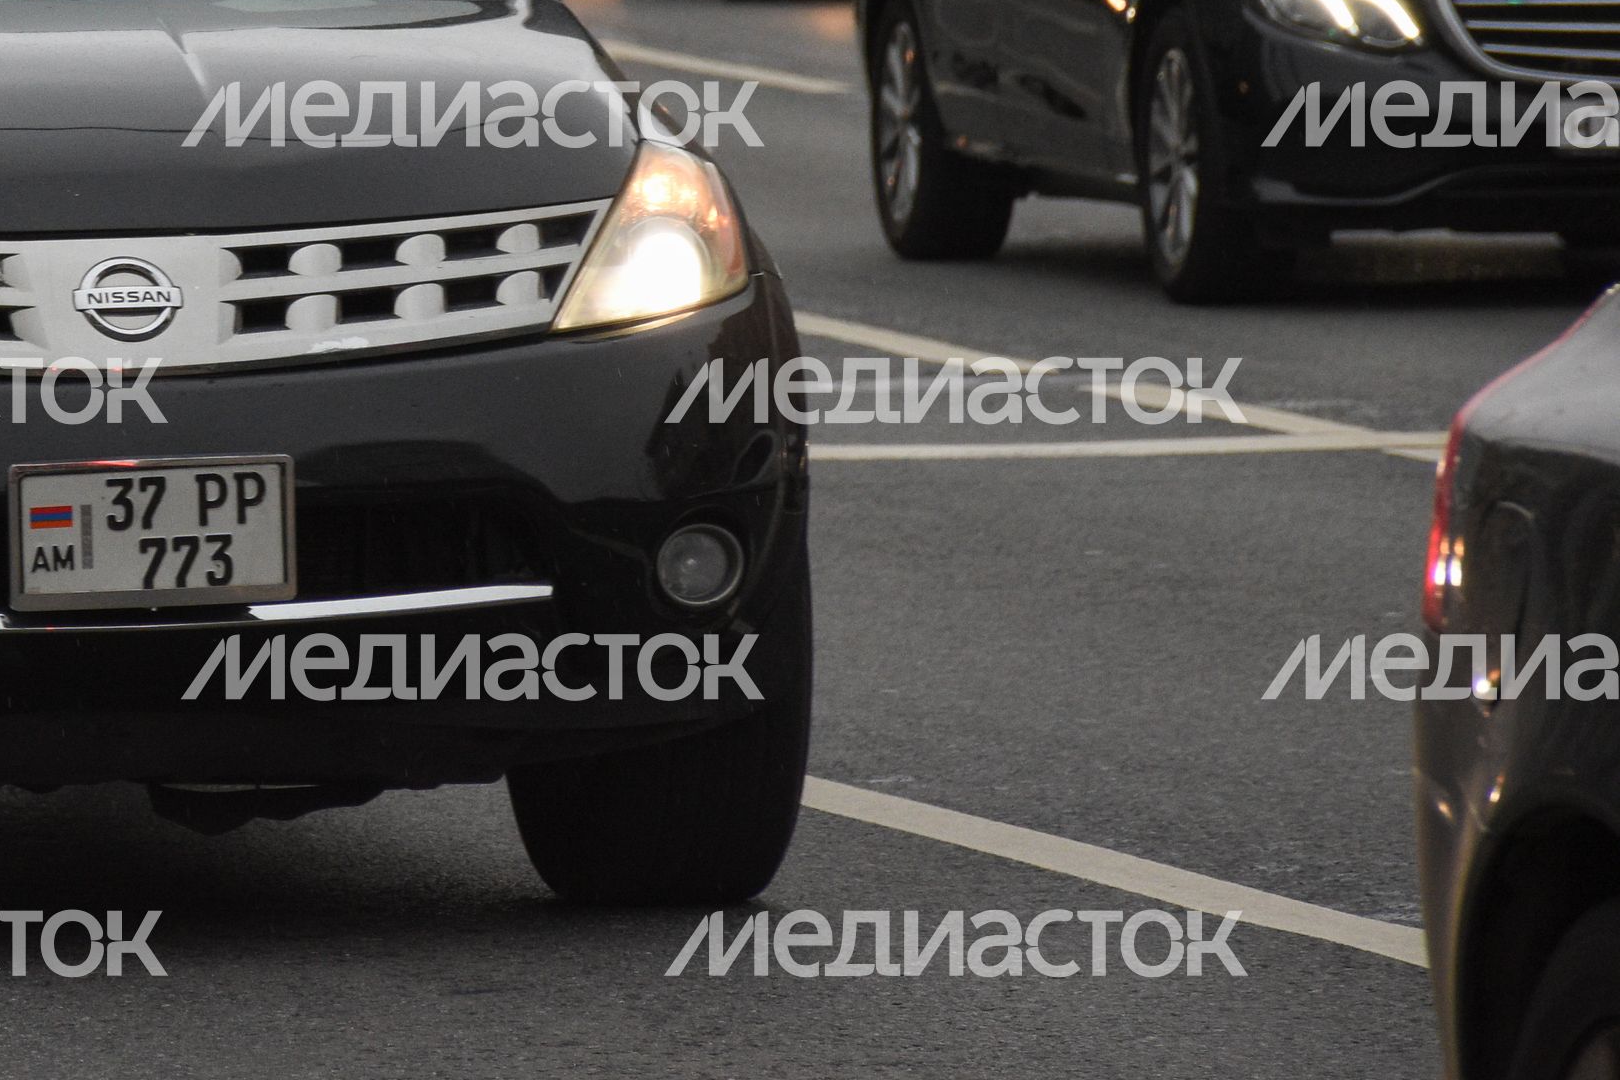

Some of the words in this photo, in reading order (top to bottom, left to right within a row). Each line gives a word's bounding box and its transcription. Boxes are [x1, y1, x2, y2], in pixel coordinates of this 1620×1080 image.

[86, 289, 173, 305] NISSAN
[105, 476, 166, 532] 37
[195, 471, 267, 527] PP
[30, 544, 75, 574] AM
[138, 534, 234, 590] 773
